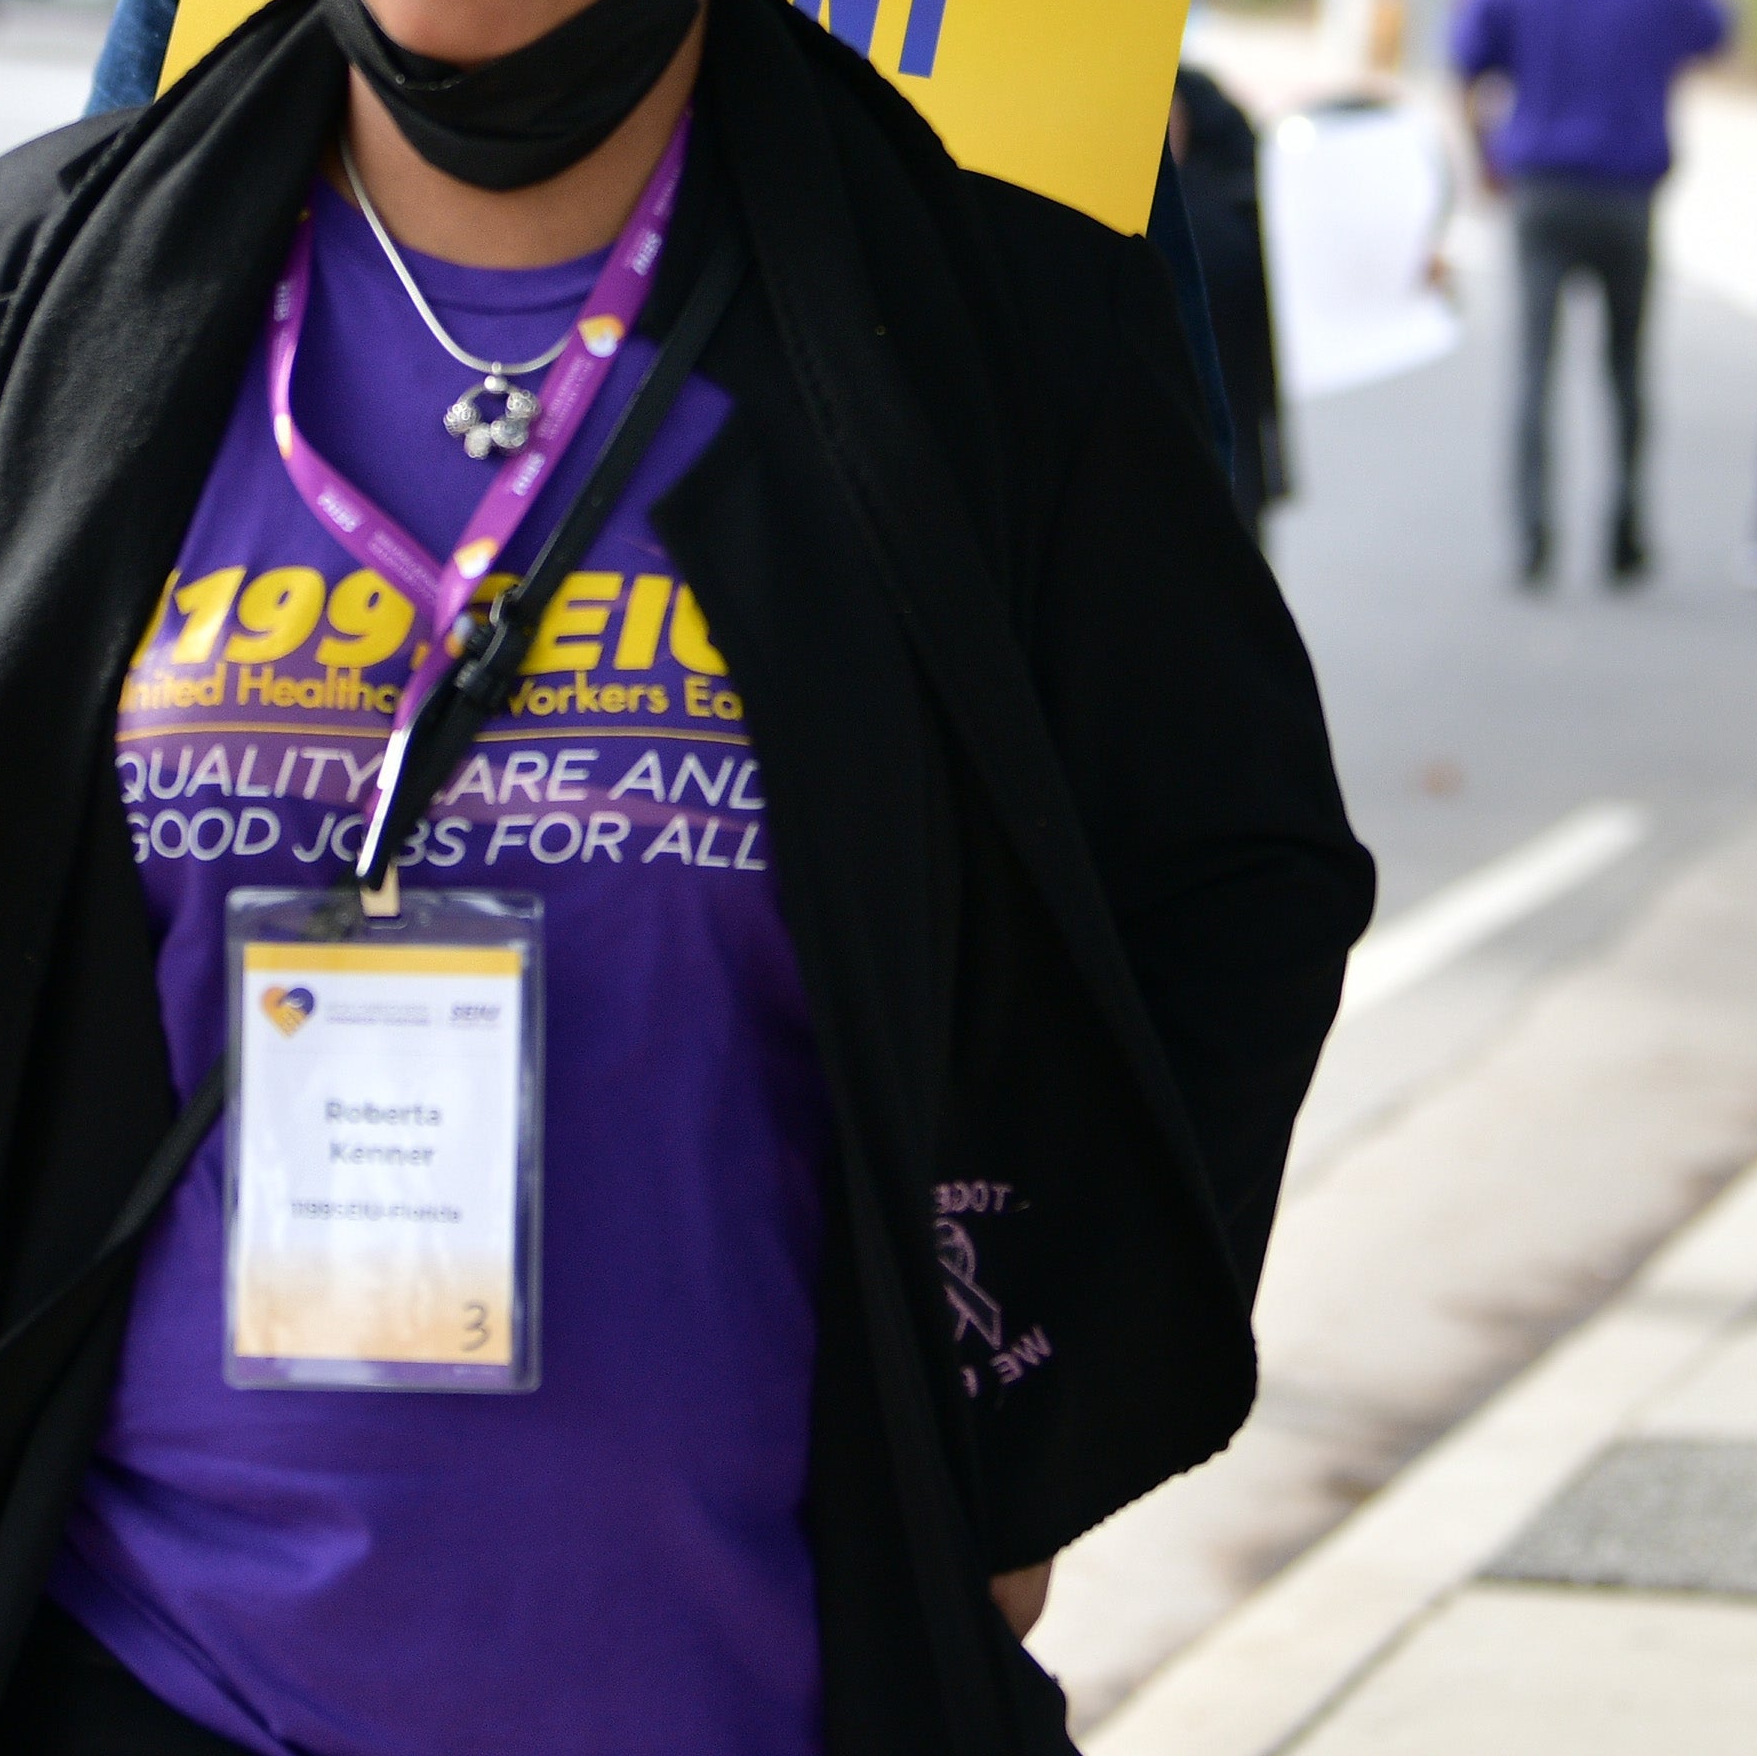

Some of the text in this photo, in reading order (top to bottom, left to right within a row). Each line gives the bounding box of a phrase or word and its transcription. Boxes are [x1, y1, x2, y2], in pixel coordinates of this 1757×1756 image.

[433, 748, 600, 806] ARE
[484, 810, 633, 866] FOR
[642, 813, 768, 872] ALL
